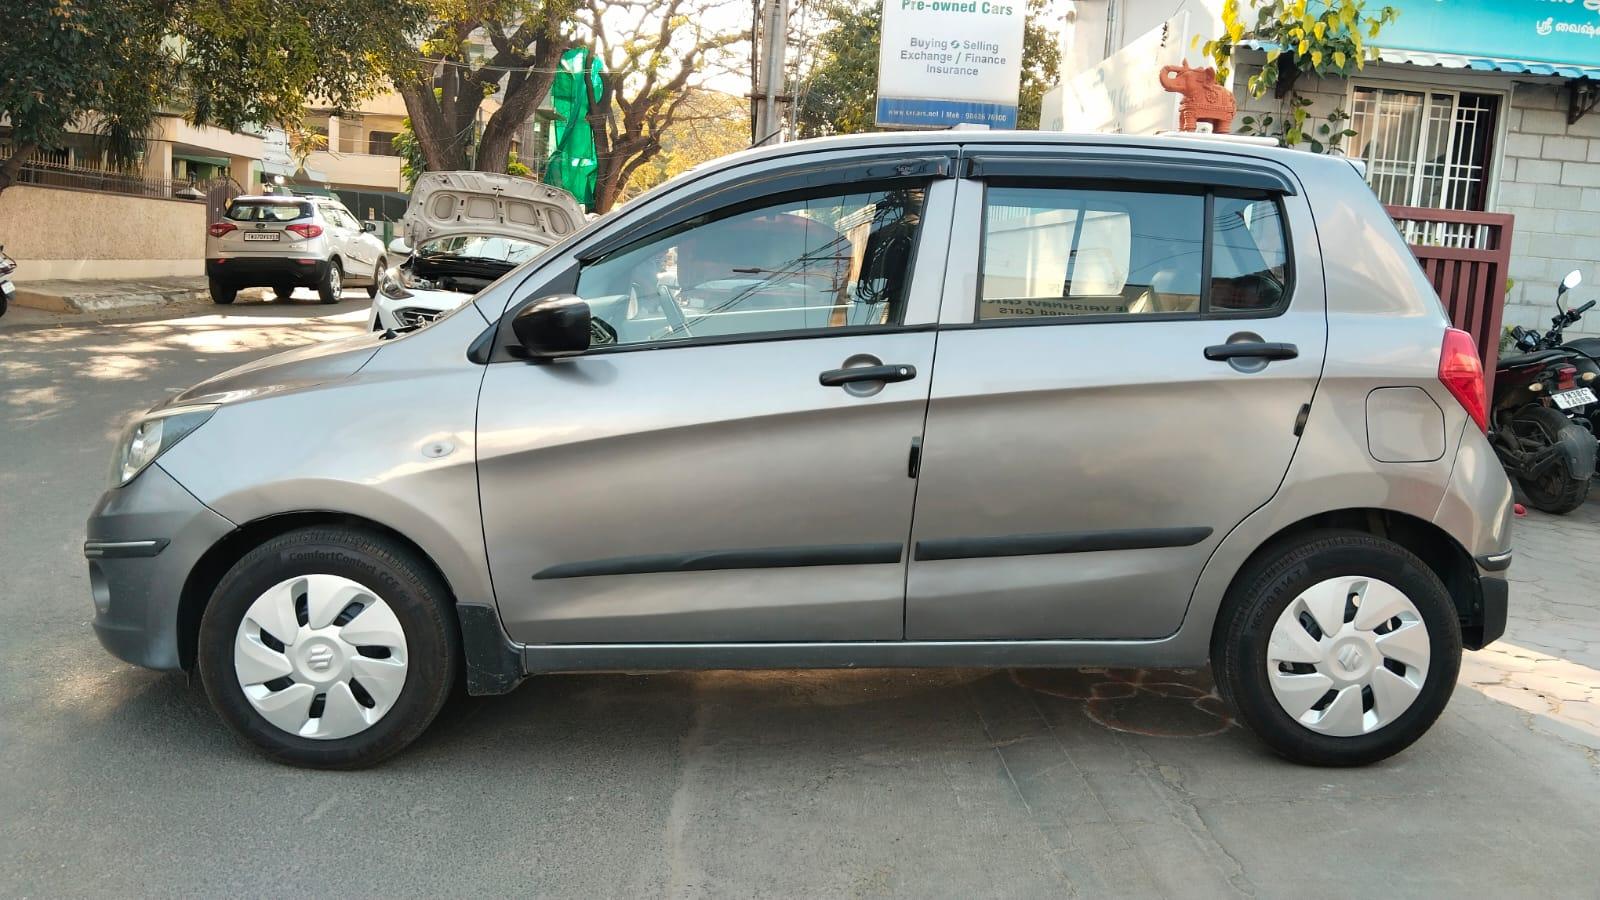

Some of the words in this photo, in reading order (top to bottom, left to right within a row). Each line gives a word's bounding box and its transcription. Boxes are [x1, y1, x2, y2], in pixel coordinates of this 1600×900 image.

[901, 0, 976, 13] Pre-owned
[981, 0, 1013, 15] Cars
[910, 37, 948, 50] Buying
[963, 41, 999, 54] Selling
[900, 50, 953, 63] Exchange
[965, 53, 1006, 65] Finance
[926, 64, 979, 76] Insurance
[289, 550, 377, 575] ComfortContact
